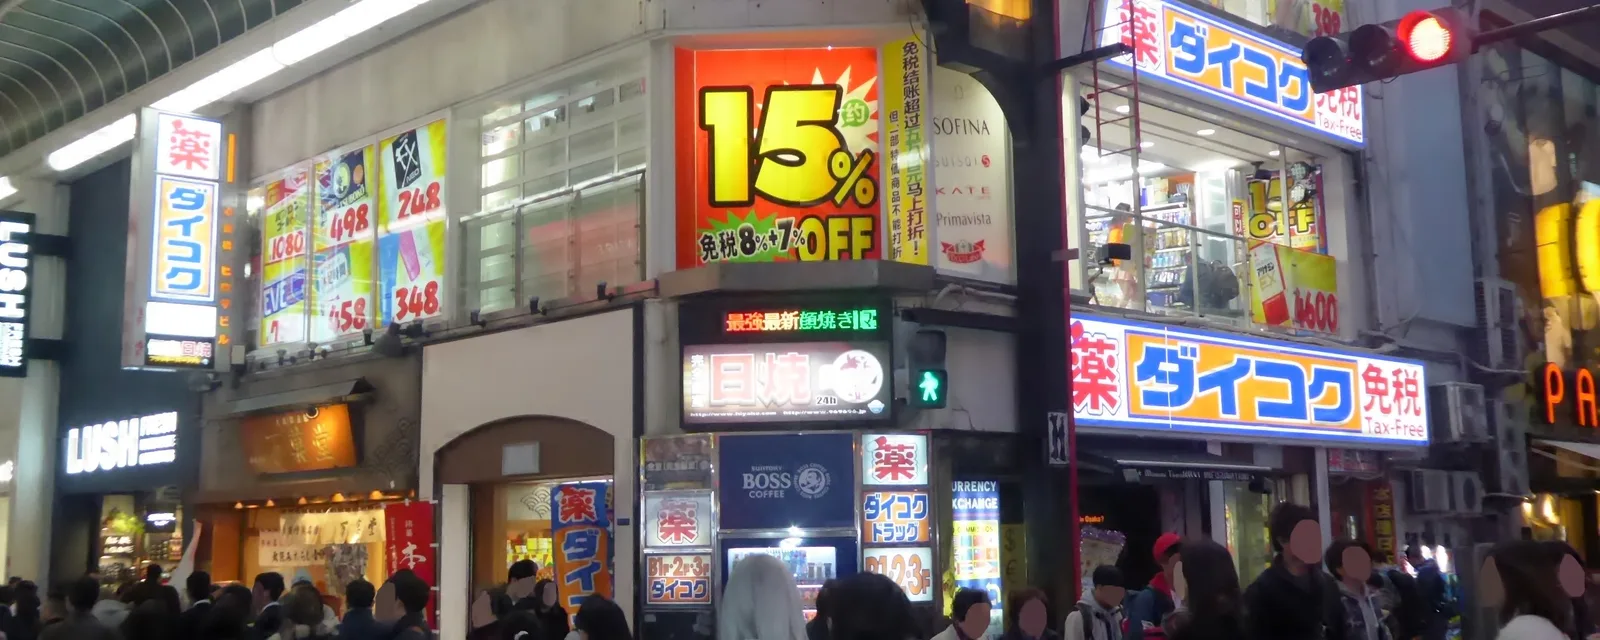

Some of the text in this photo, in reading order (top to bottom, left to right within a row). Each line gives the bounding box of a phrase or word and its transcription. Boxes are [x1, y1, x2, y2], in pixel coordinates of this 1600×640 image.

[1170, 20, 1311, 114] ダイコク
[170, 119, 210, 170] 薬
[933, 116, 990, 136] SOFINA
[1317, 112, 1362, 139] Tax-Free
[699, 84, 878, 208] 15%
[398, 181, 441, 220] 248
[935, 186, 990, 195] KATE
[330, 203, 369, 241] 498
[798, 214, 875, 260] OFF
[936, 211, 992, 227] Primavista
[166, 186, 208, 291] ダイコク
[272, 231, 304, 261] 1080
[395, 280, 439, 321] 348
[1071, 321, 1119, 412] 薬
[1137, 344, 1354, 424] ダイコク
[816, 396, 838, 405] 24h
[1362, 363, 1422, 417] 免税
[66, 417, 139, 475] LUSH
[1365, 416, 1425, 438] Tax-Free
[874, 436, 917, 482] 薬
[742, 473, 792, 490] BOSS
[748, 490, 785, 498] COFFEE
[559, 486, 597, 524] 薬
[657, 500, 699, 544] 薬
[864, 493, 929, 521] ダイコク
[651, 579, 709, 600] ダイコク
